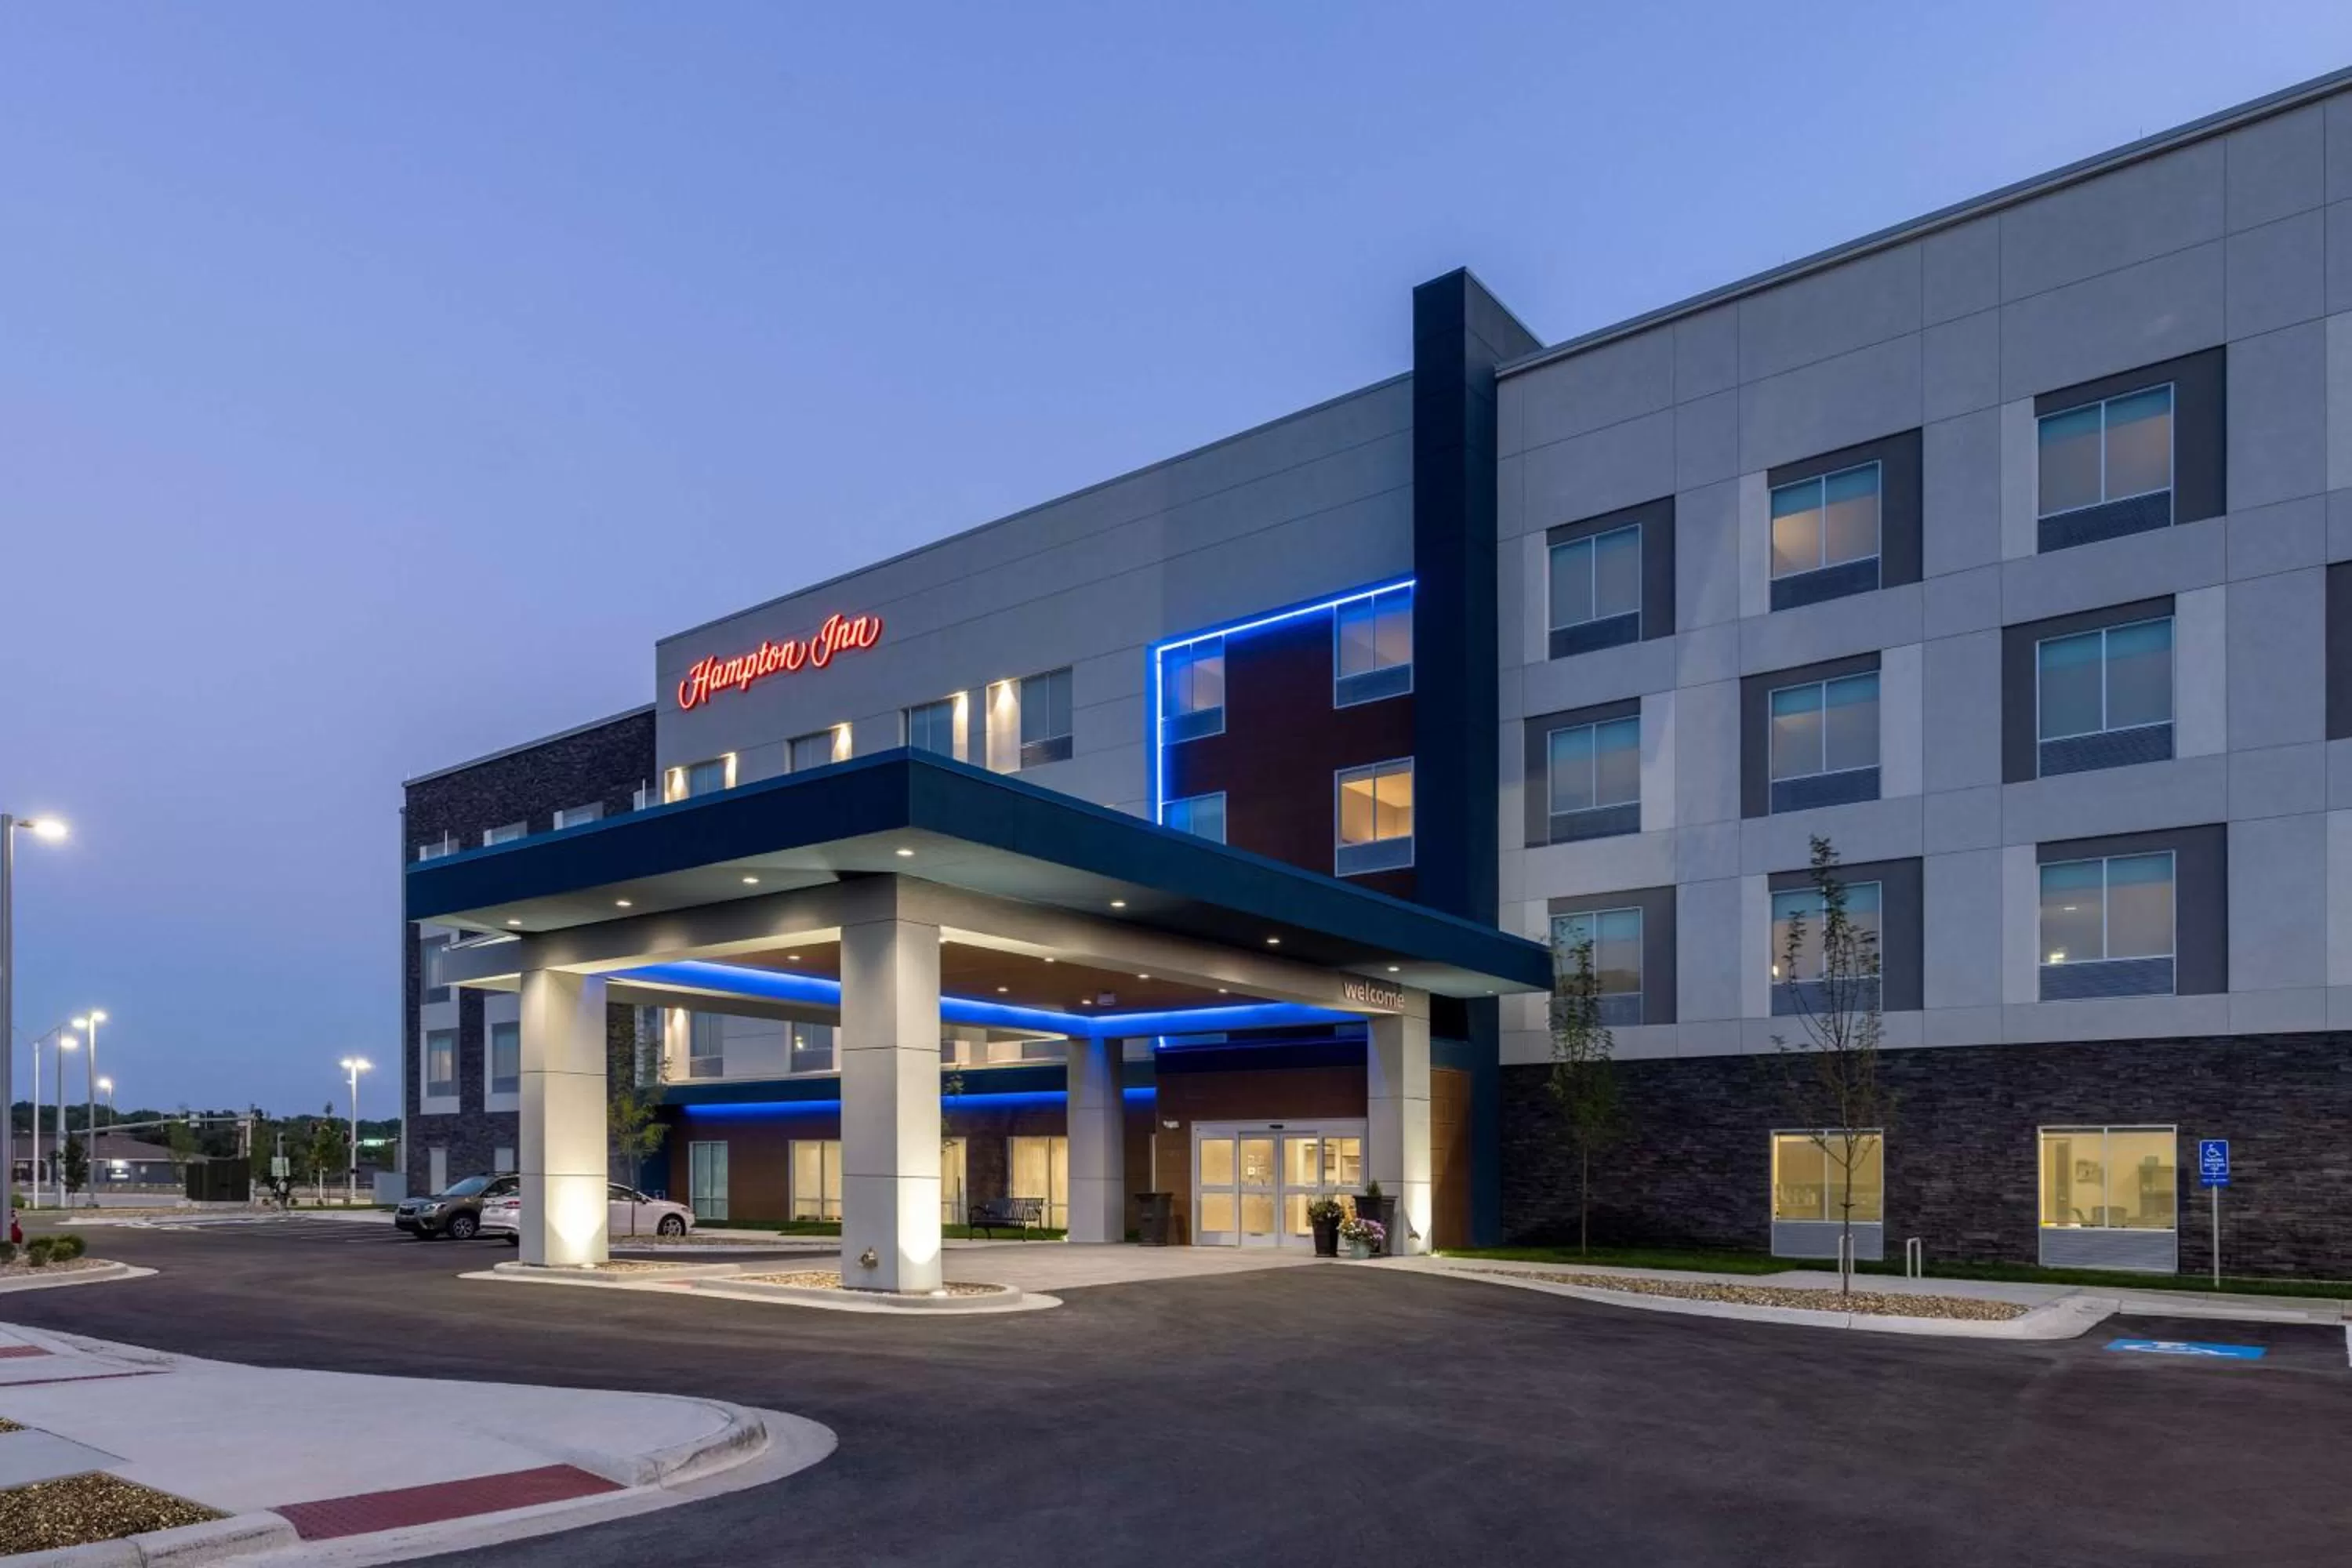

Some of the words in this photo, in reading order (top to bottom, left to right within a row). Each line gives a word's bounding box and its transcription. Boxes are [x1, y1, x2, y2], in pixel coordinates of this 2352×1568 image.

[678, 641, 807, 710] Hampton
[811, 613, 881, 666] Inn
[1344, 981, 1405, 1009] welcome
